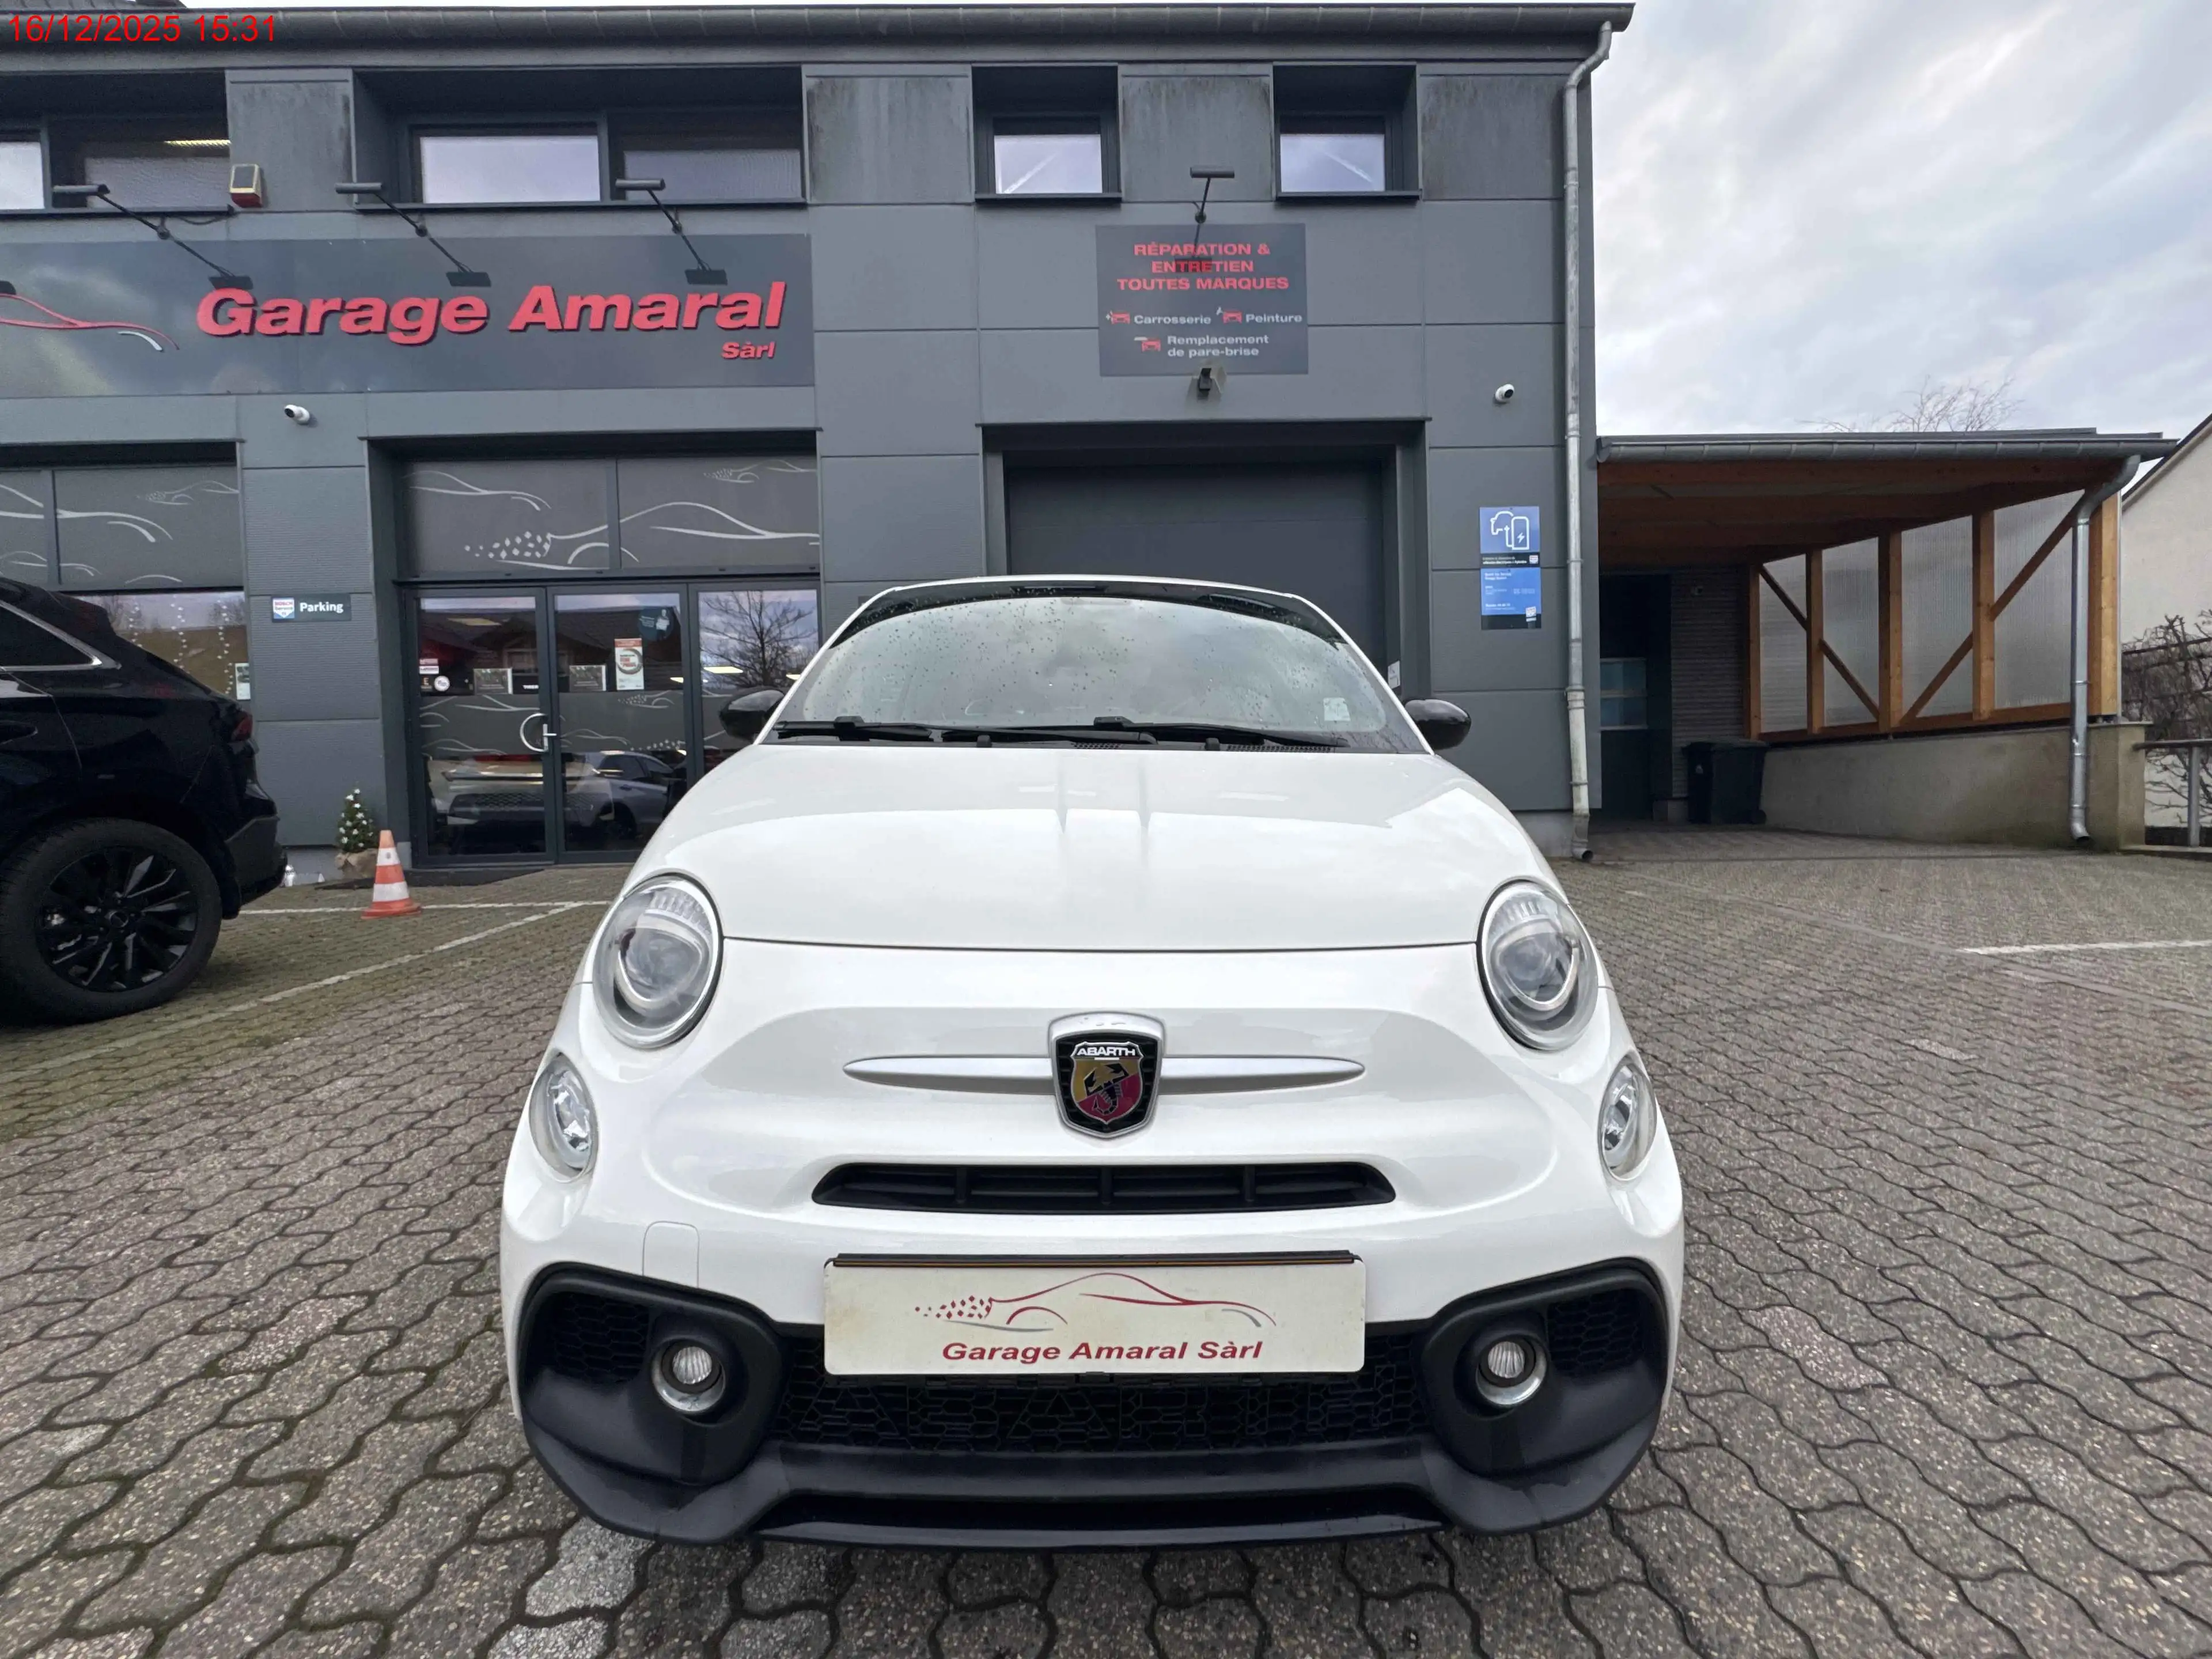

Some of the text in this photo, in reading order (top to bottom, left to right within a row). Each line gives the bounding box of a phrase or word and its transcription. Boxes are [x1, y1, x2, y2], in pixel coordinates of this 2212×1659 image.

[1134, 241, 1271, 256] RÉPARATION &
[1152, 260, 1254, 274] ENTRETIEN
[1117, 276, 1290, 291] TOUTES MARQUES
[196, 281, 786, 346] Garage Amaral
[1134, 315, 1211, 325] Carrosserie
[1246, 313, 1303, 324] Peinture
[1167, 335, 1269, 346] Remplacement
[721, 340, 776, 359] Sàrl
[1167, 347, 1260, 358] de pare-brise
[300, 601, 344, 613] Parking
[1076, 1046, 1136, 1056] ABARTH
[942, 1340, 1263, 1364] Garage Amaral Sàrl
